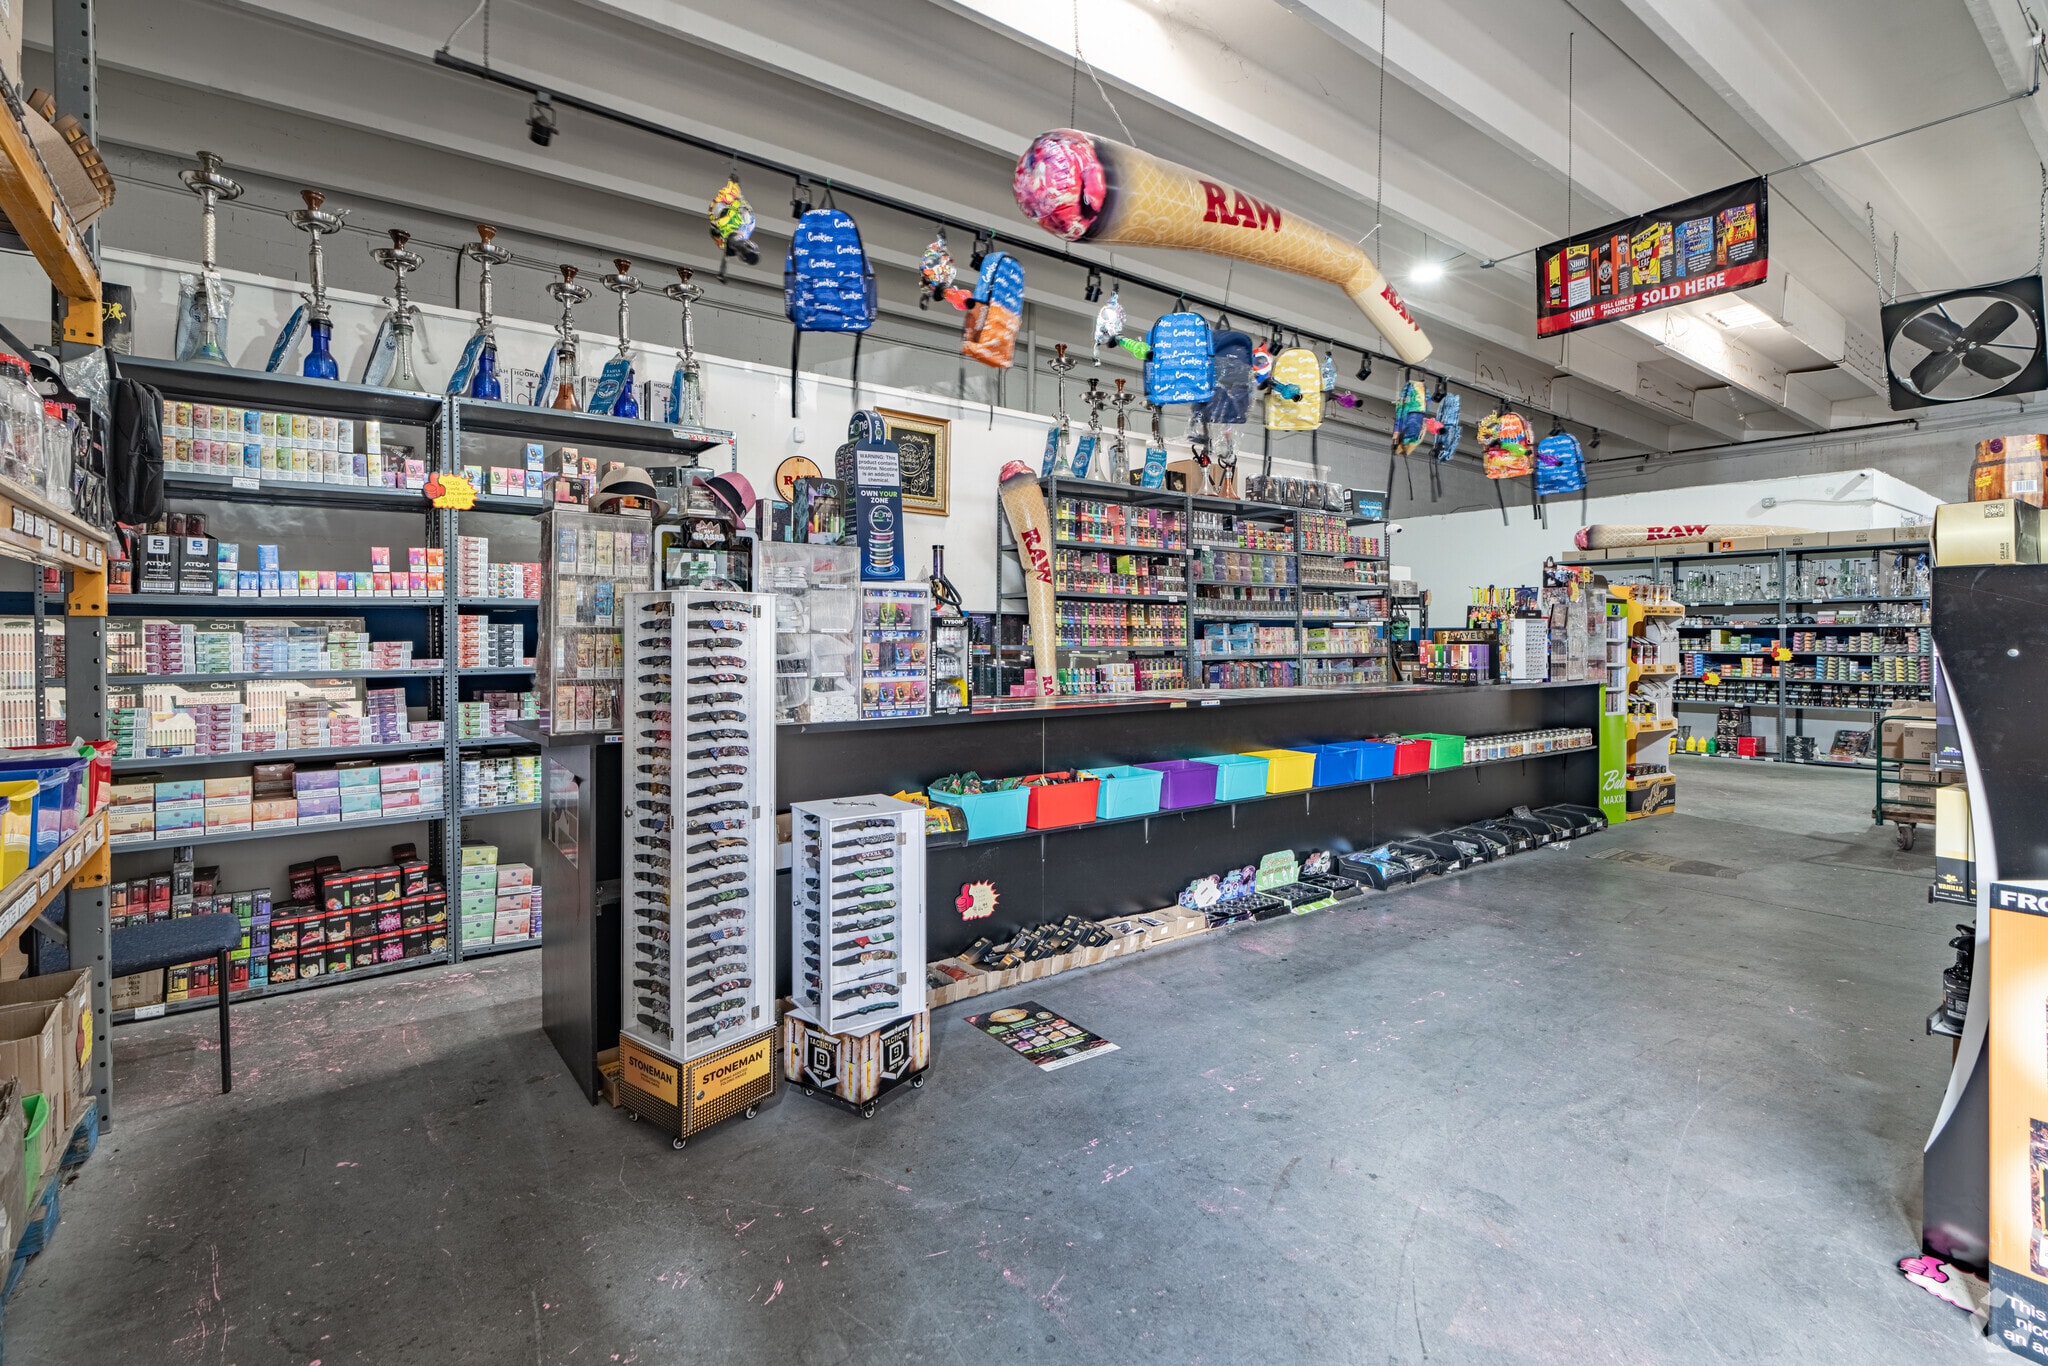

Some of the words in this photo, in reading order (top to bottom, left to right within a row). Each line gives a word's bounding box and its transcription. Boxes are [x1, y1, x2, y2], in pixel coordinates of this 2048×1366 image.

[1198, 180, 1281, 232] RAW
[808, 232, 834, 242] Cookies
[836, 245, 862, 255] Cookies
[1636, 247, 1652, 260] SHOW
[809, 258, 836, 268] Cookies
[1638, 258, 1650, 268] LEAF
[1641, 282, 1680, 306] SOLD
[1684, 272, 1726, 296] HERE
[1380, 282, 1420, 332] RAW
[1600, 302, 1614, 310] FULL
[1614, 298, 1628, 306] LINE
[1603, 304, 1634, 316] PRODUCTS
[1570, 306, 1596, 321] SHOW
[1172, 329, 1196, 337] Cookies
[1180, 357, 1202, 366] Cookies
[514, 370, 540, 379] HOOKA
[1172, 391, 1194, 400] Cookies
[850, 420, 868, 434] zone
[1647, 524, 1710, 541] RAW
[1021, 527, 1053, 585] RAW
[1042, 675, 1054, 696] RA
[860, 850, 882, 858] TEXAS
[1938, 883, 1964, 892] VANILLA
[810, 1037, 836, 1052] TACTICAL
[884, 1030, 909, 1046] TACTICAL
[629, 1056, 672, 1085] STONEMAN
[702, 1050, 763, 1085] STONEMAN
[2006, 1295, 2047, 1322] This
[2004, 1329, 2028, 1347] an
